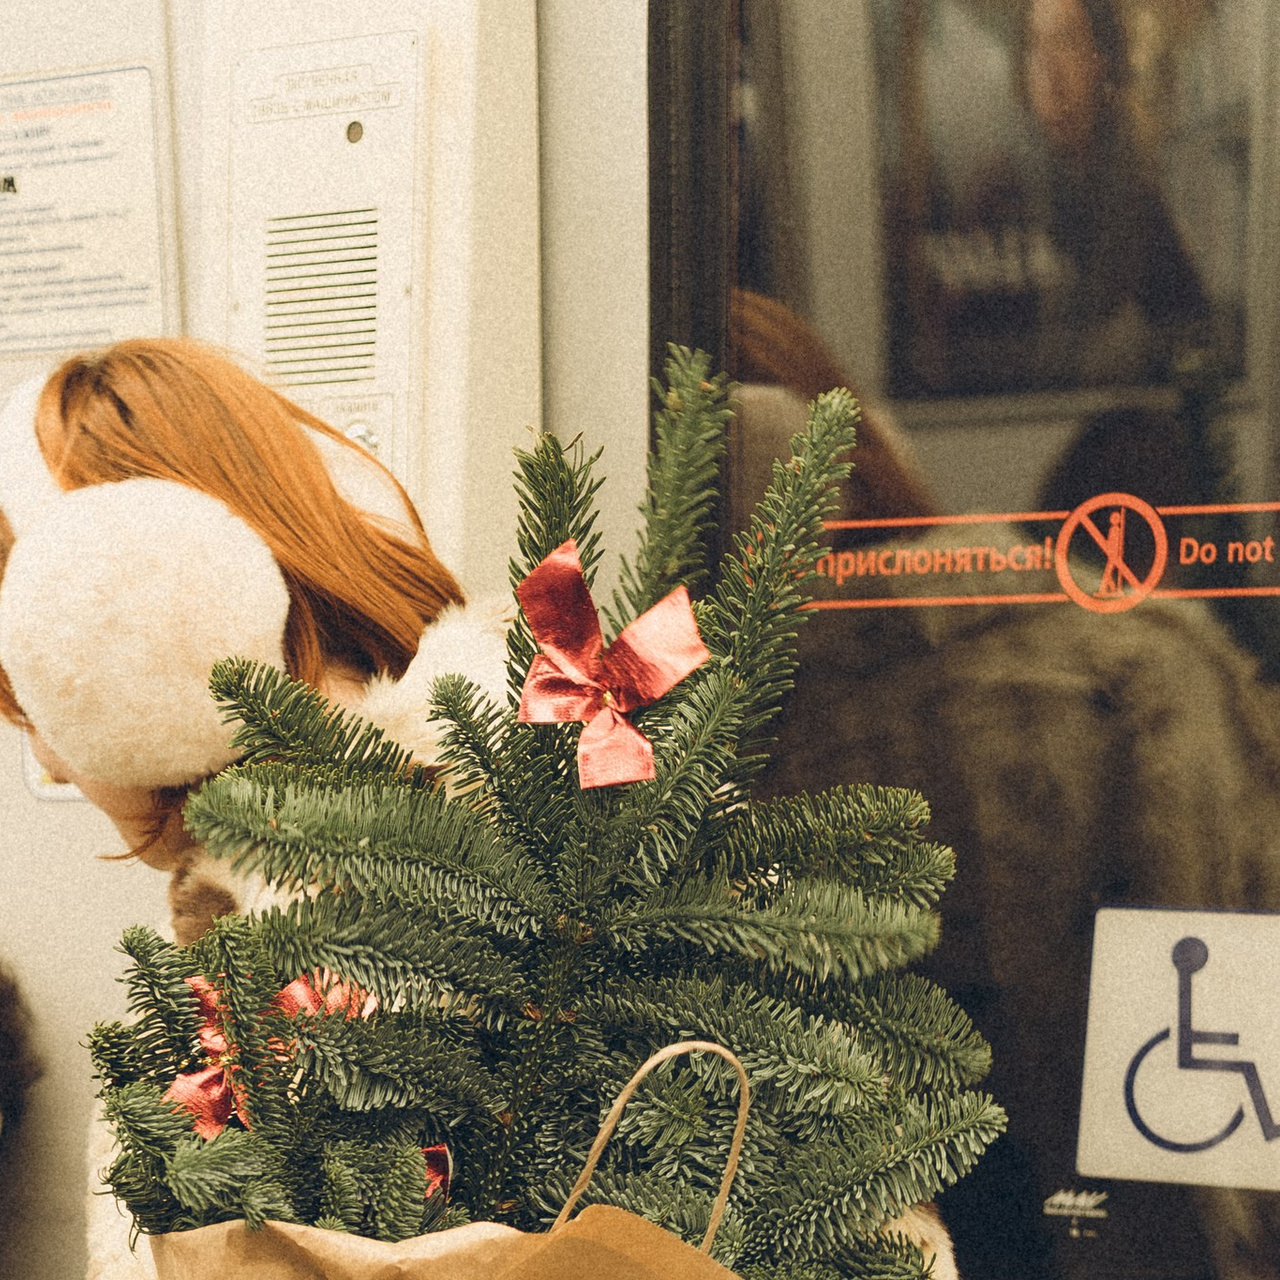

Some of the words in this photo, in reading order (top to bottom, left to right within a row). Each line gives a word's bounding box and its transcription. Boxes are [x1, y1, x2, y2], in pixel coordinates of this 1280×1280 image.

[817, 536, 1053, 586] прислоняться!
[1180, 537, 1218, 565] Do
[1227, 534, 1276, 564] not
